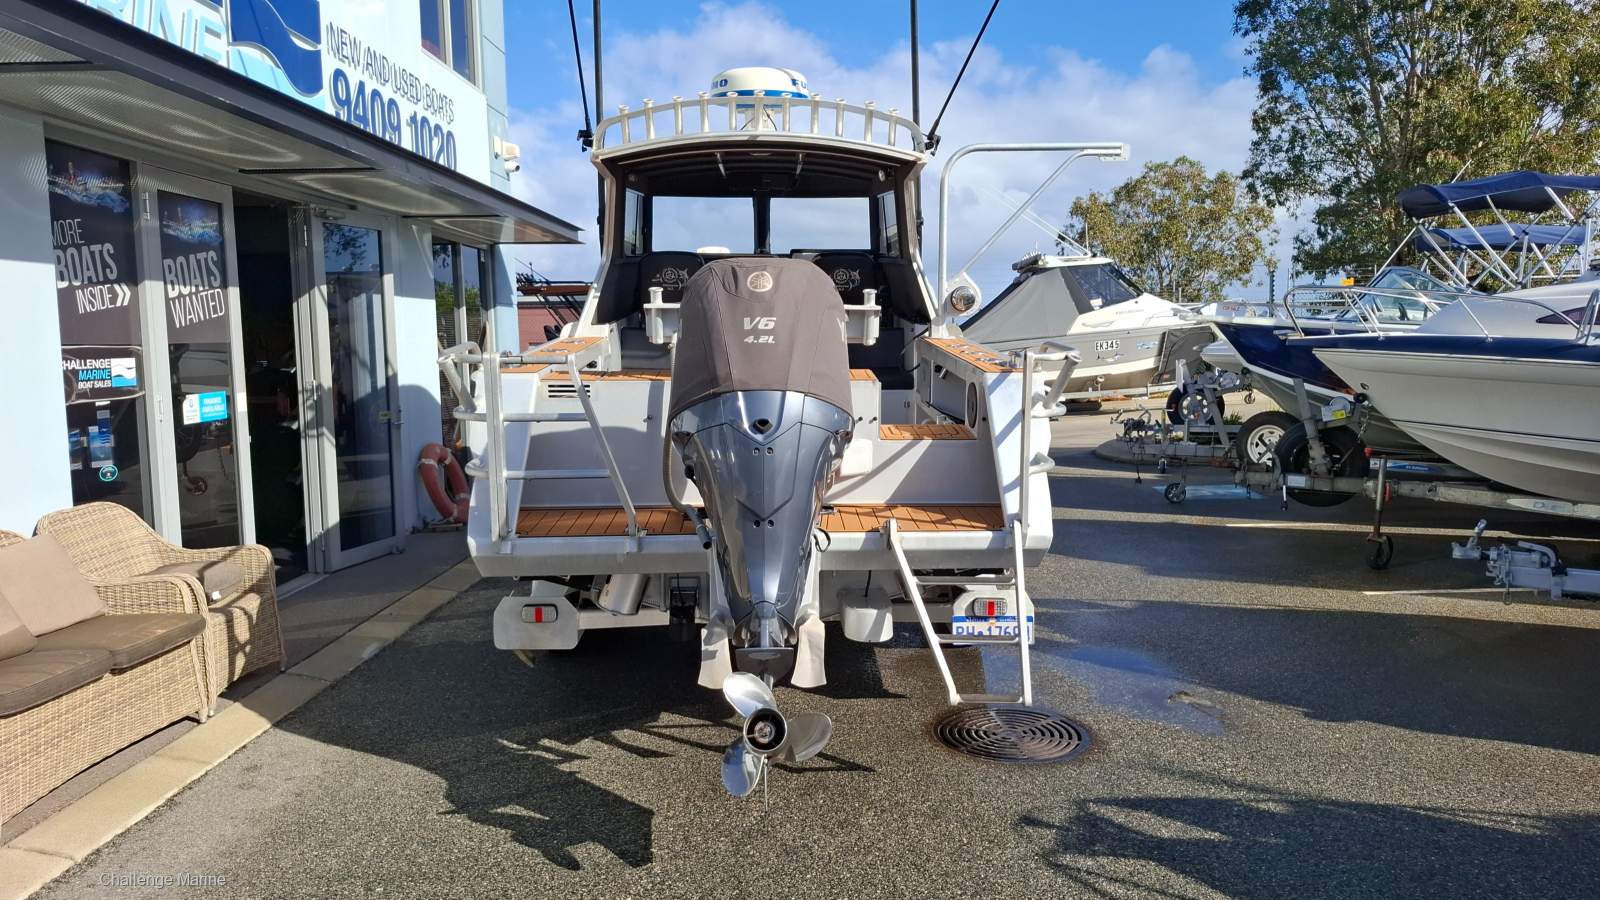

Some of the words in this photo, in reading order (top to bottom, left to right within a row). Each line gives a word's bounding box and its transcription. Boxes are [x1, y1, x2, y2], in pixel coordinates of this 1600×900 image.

[327, 21, 362, 69] NEW
[364, 46, 391, 85] AND
[392, 63, 422, 104] USED
[424, 83, 455, 124] BOATS
[331, 68, 402, 147] 9409
[407, 111, 458, 171] 1020
[55, 242, 118, 289] BOATS
[163, 250, 221, 299] BOATS
[75, 283, 115, 314] INSIDE
[170, 288, 225, 329] WANTED
[743, 316, 777, 330] V6
[743, 335, 776, 344] 4.2L
[1095, 340, 1120, 351] EK345
[78, 381, 94, 390] BOAT
[94, 379, 111, 389] SALES
[79, 369, 111, 381] MARINE
